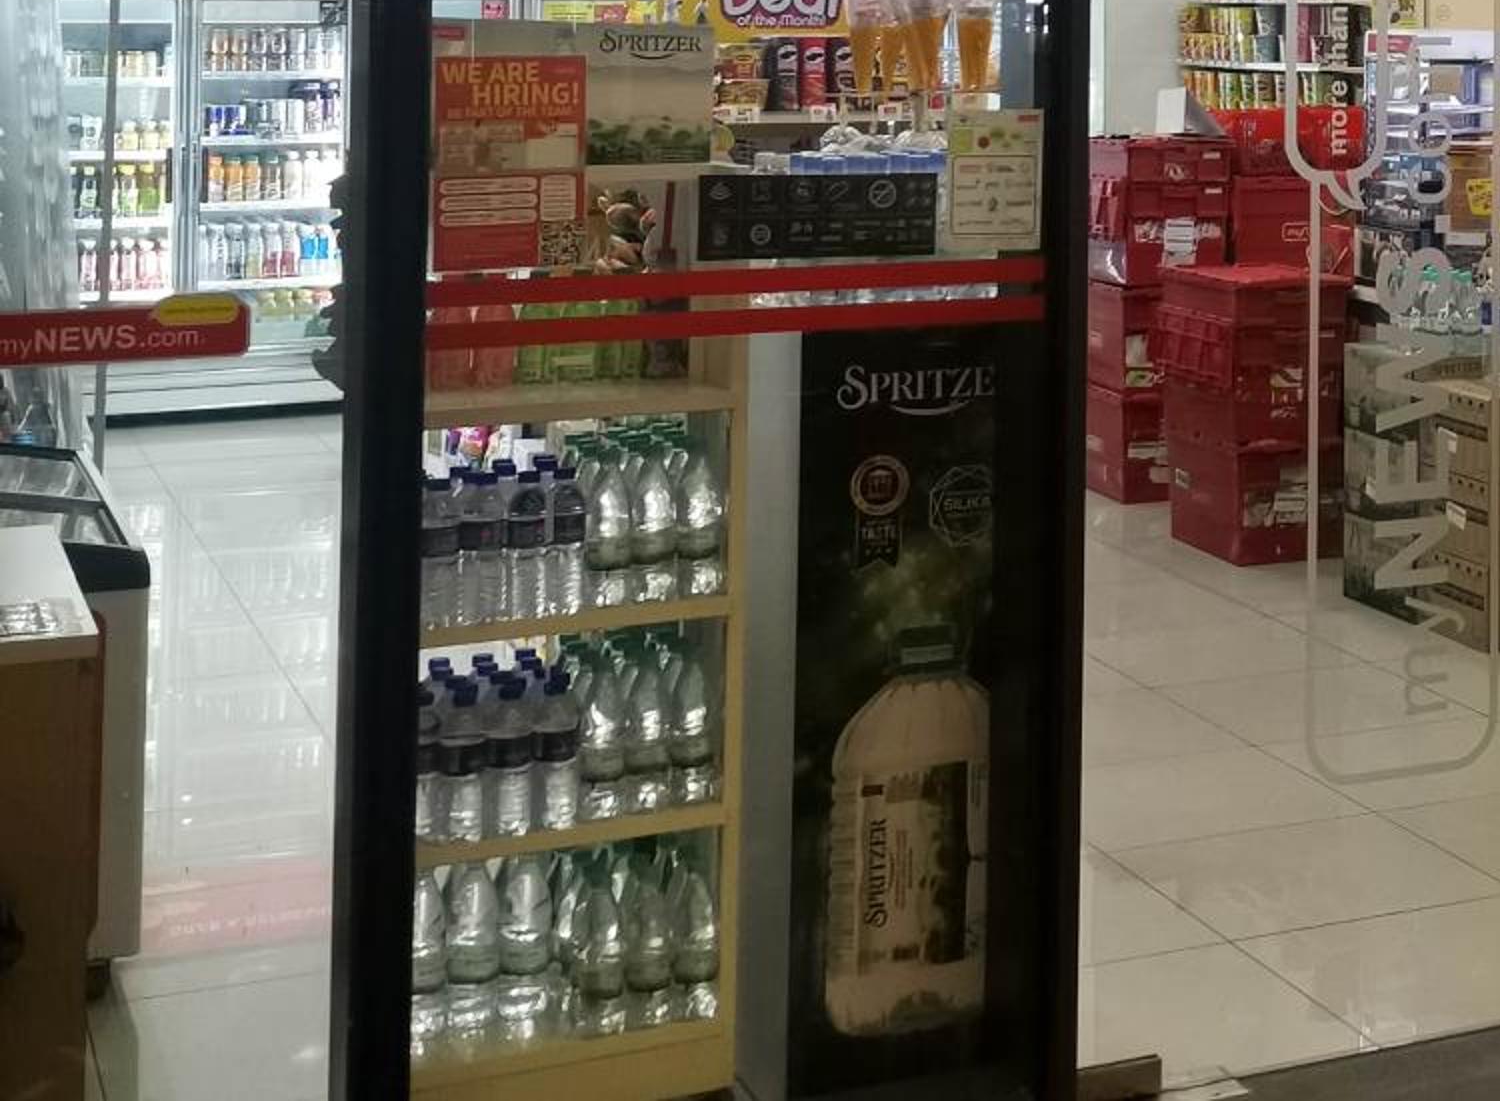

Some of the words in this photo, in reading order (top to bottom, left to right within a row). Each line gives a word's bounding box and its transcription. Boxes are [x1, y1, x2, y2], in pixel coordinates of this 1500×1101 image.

[599, 29, 702, 53] SPRITZER
[440, 61, 482, 84] WE
[487, 60, 541, 84] ARE
[471, 82, 579, 107] HIRING!
[1330, 79, 1349, 156] more
[836, 364, 994, 411] SPRITZE
